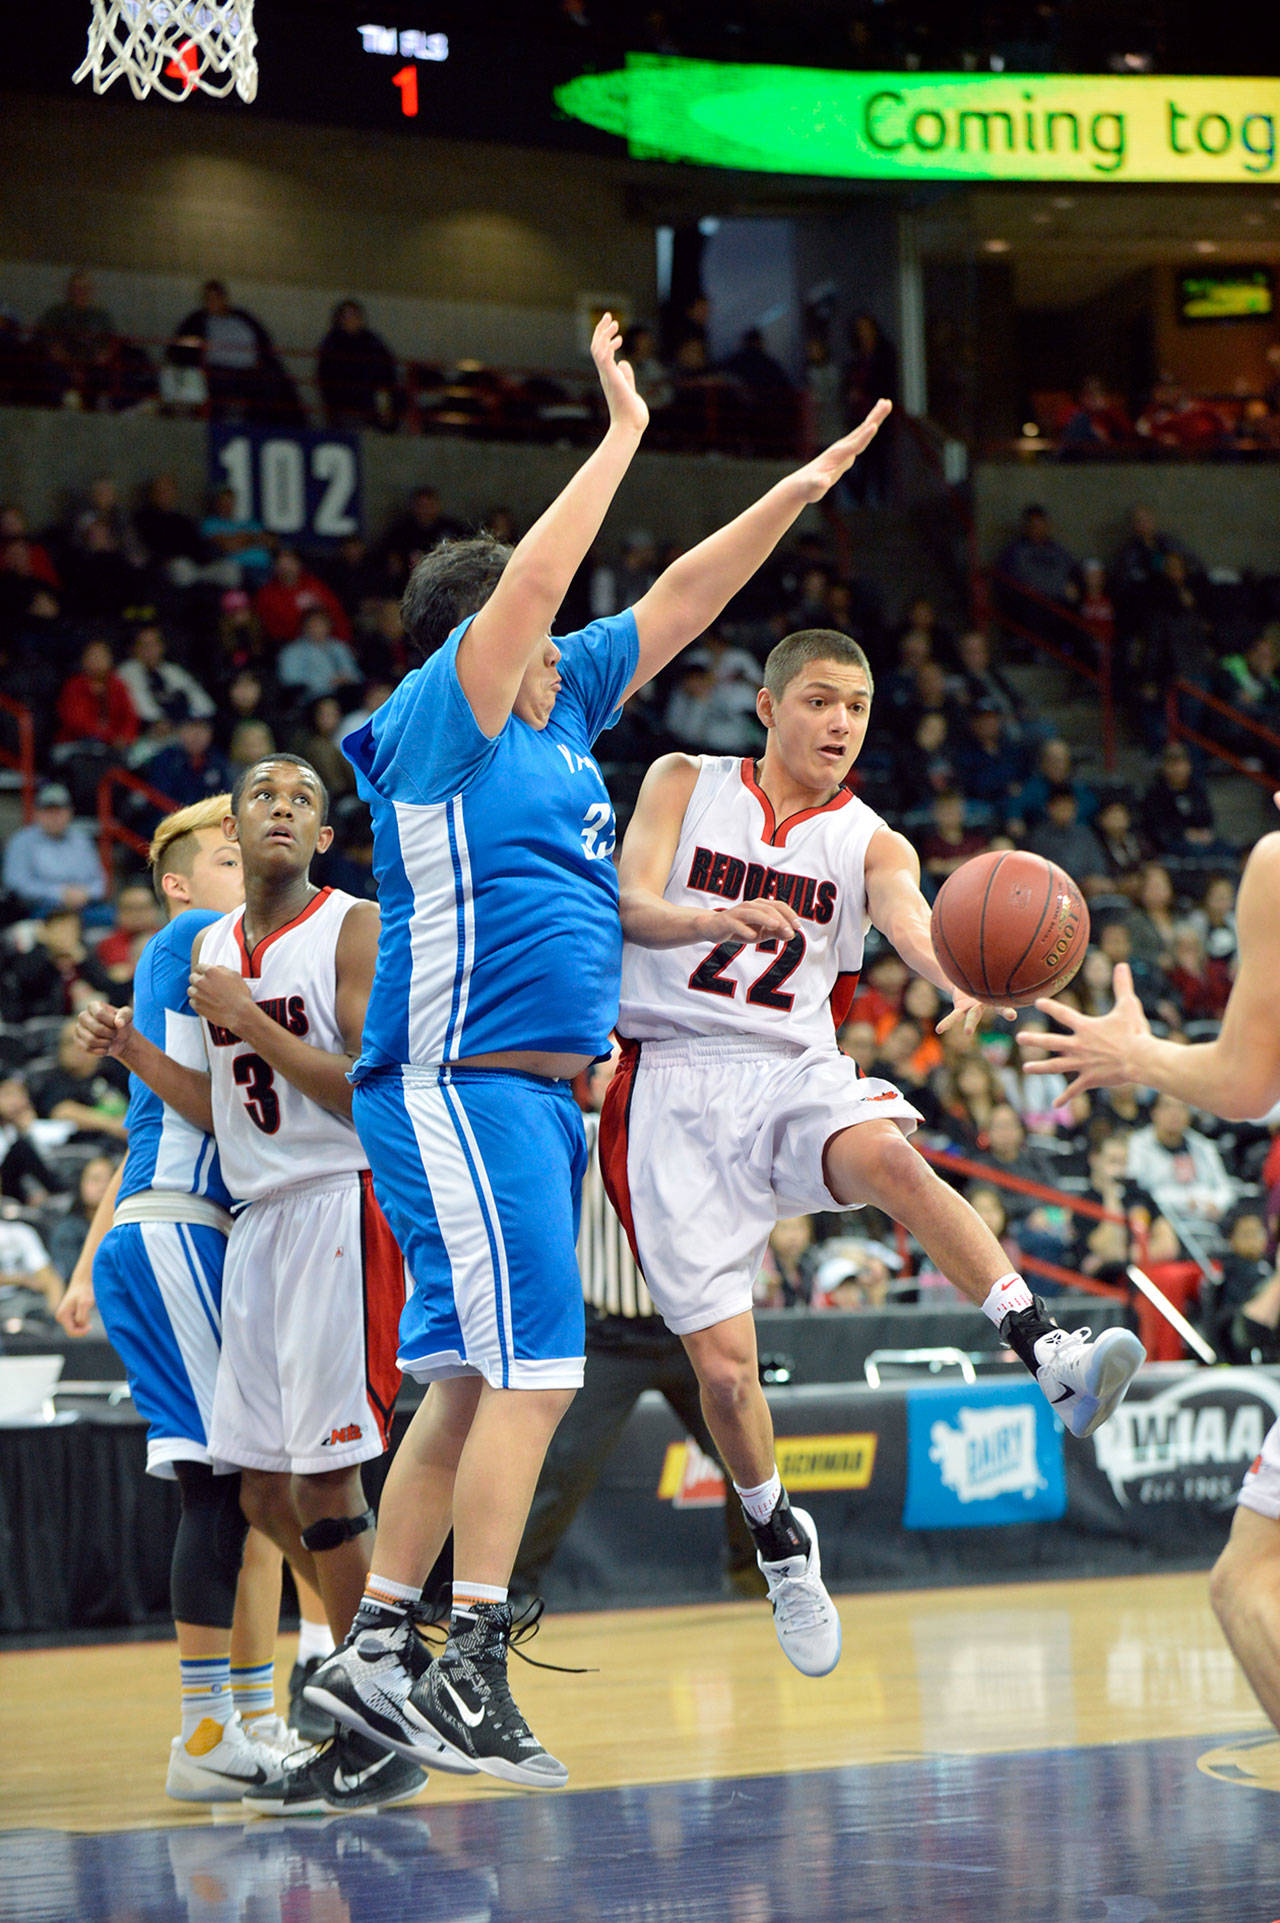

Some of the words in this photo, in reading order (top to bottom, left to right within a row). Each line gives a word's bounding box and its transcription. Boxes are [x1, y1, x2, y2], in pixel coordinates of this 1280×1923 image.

[392, 64, 419, 117] 1
[864, 91, 1126, 172] Coming
[1167, 100, 1276, 173] tog
[220, 436, 357, 537] 102
[688, 907, 807, 1012] 22
[232, 1052, 281, 1135] 3
[1130, 1405, 1264, 1464] WIAA
